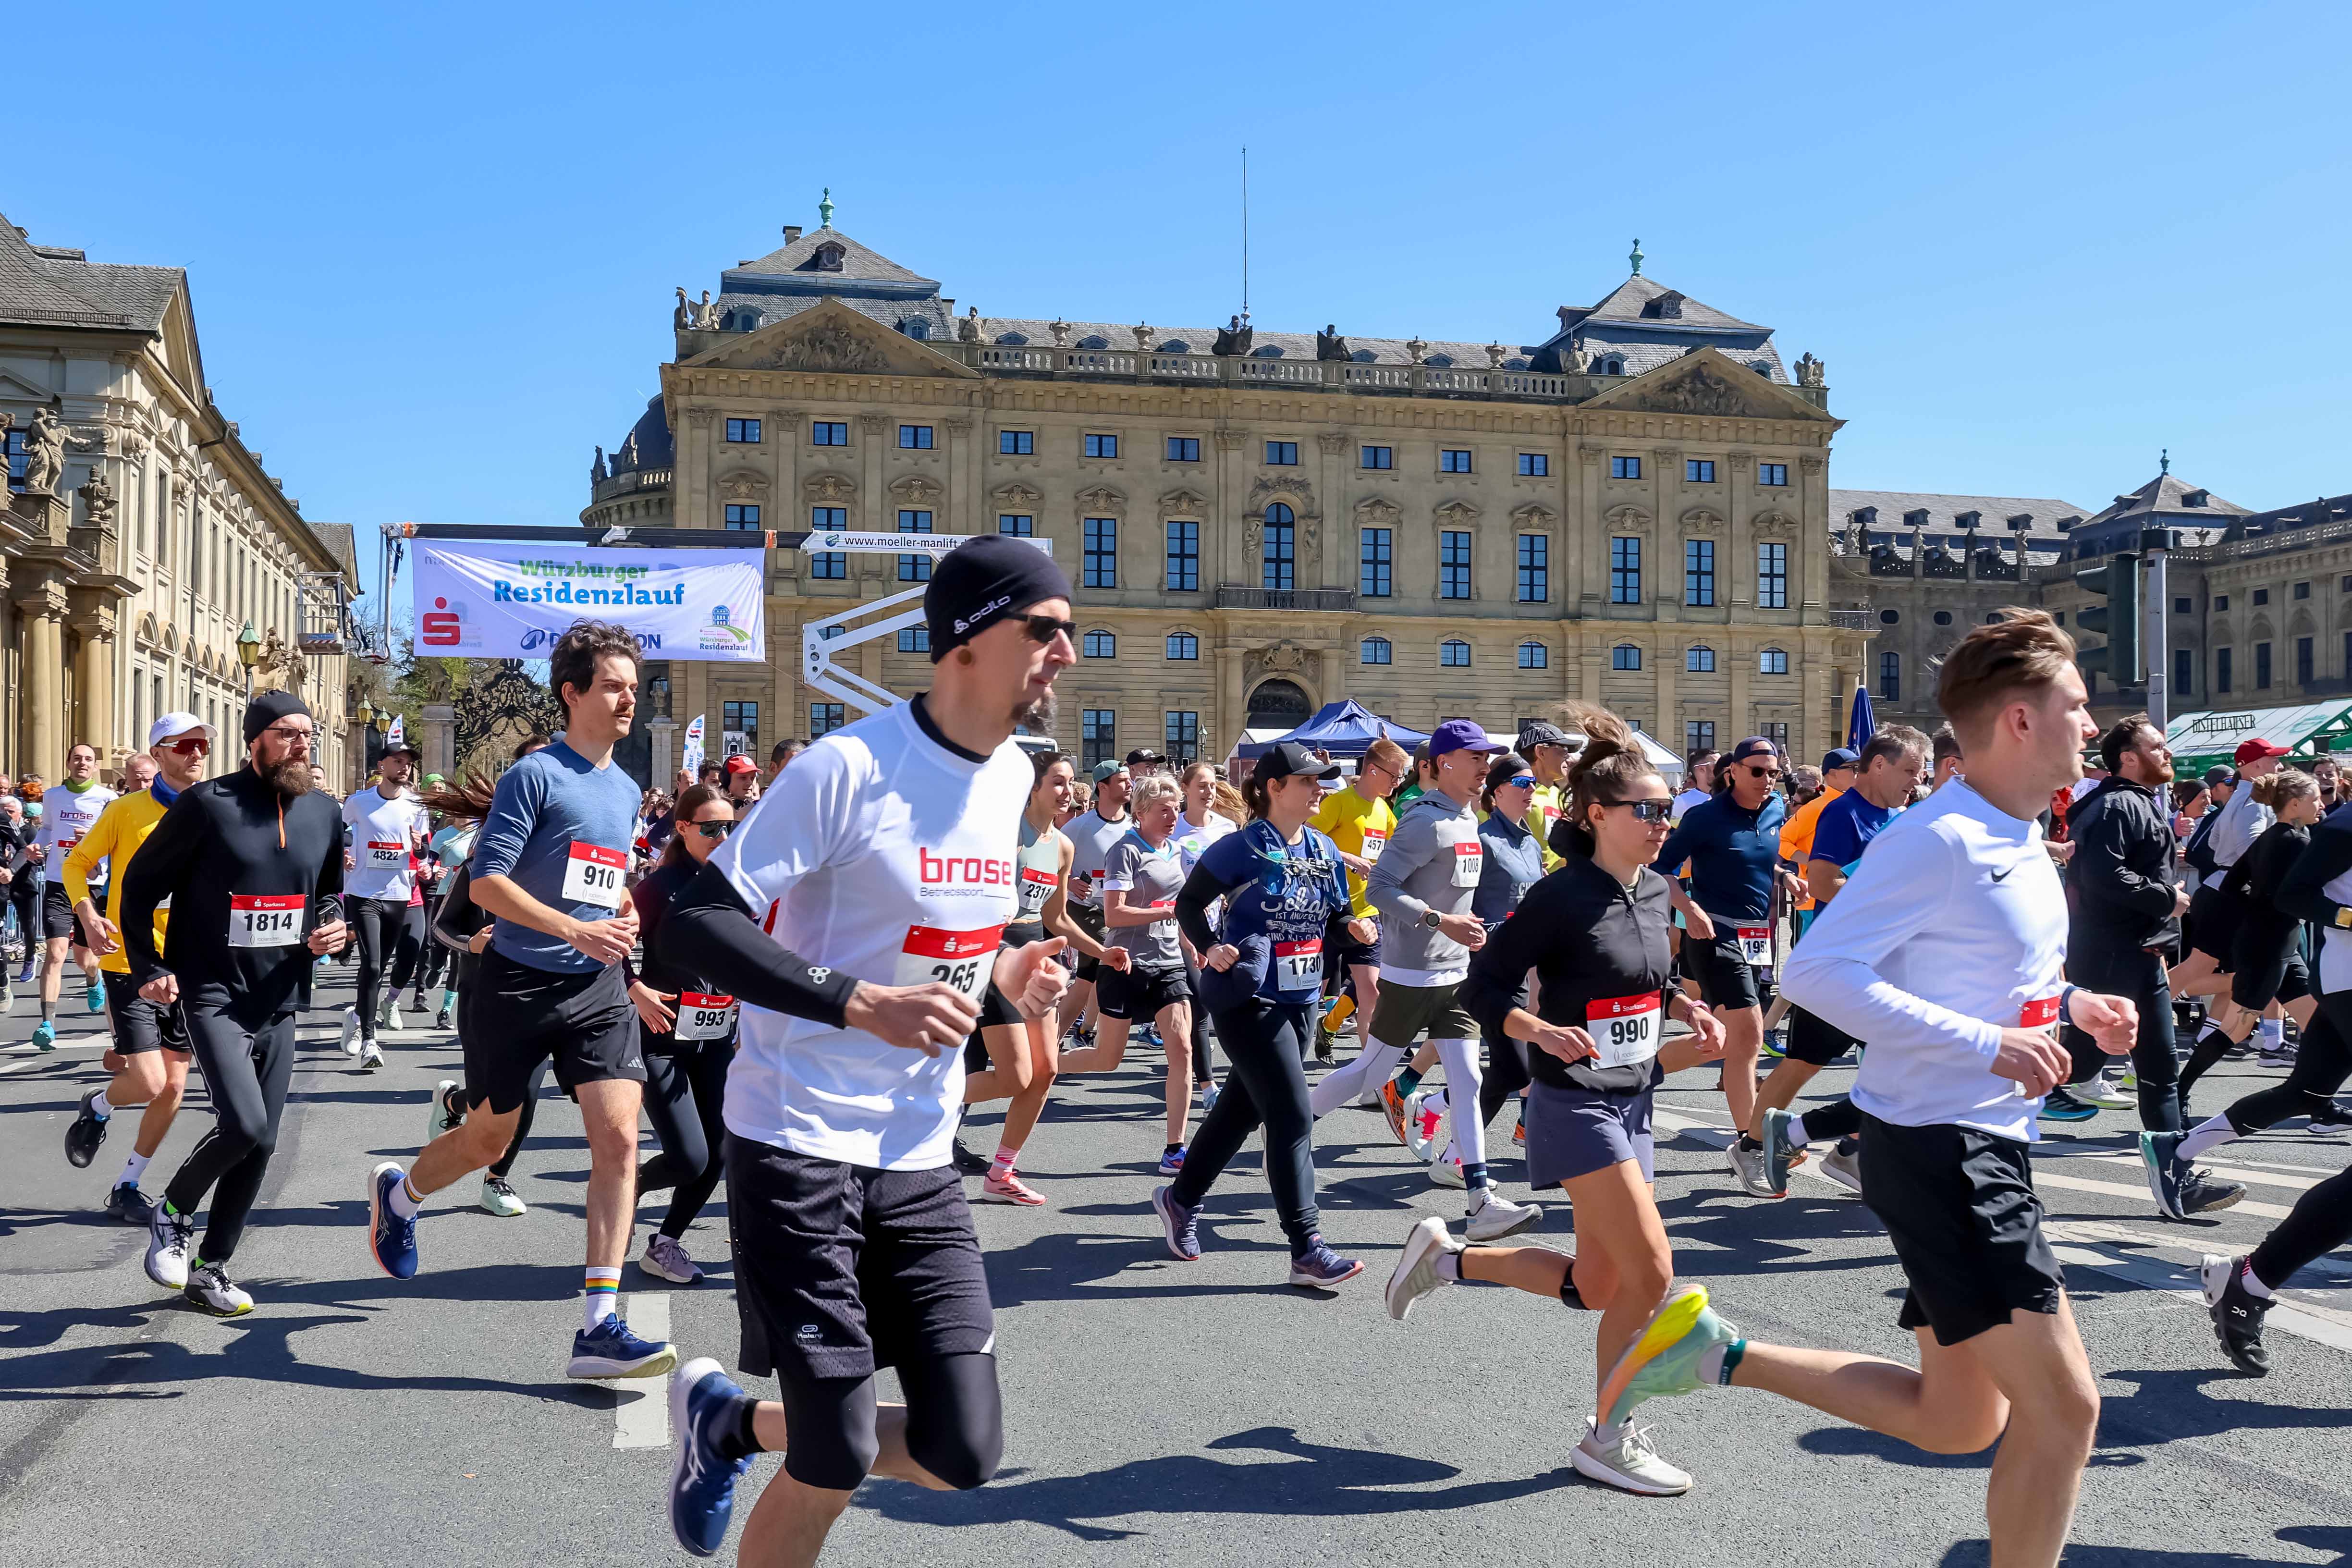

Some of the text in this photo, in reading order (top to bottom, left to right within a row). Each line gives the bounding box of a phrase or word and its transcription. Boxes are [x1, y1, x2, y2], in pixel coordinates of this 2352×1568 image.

[519, 560, 649, 583] Würzburger
[494, 580, 685, 604] Residenzlauf
[968, 596, 1011, 623] odlo
[1520, 726, 1557, 749] NIKE
[61, 810, 93, 820] brose
[373, 850, 399, 861] 4822
[919, 847, 1011, 885] brose
[1463, 858, 1479, 873] 1008
[584, 865, 614, 889] 910
[919, 887, 984, 897] Betriebssport
[244, 913, 293, 931] 1814
[1275, 912, 1316, 922] IST ANDERS
[1266, 933, 1285, 941] SIND
[1288, 956, 1321, 975] 1730
[1622, 1003, 1647, 1012] Sparkasse
[695, 1010, 726, 1027] 993
[1611, 1017, 1648, 1045] 990
